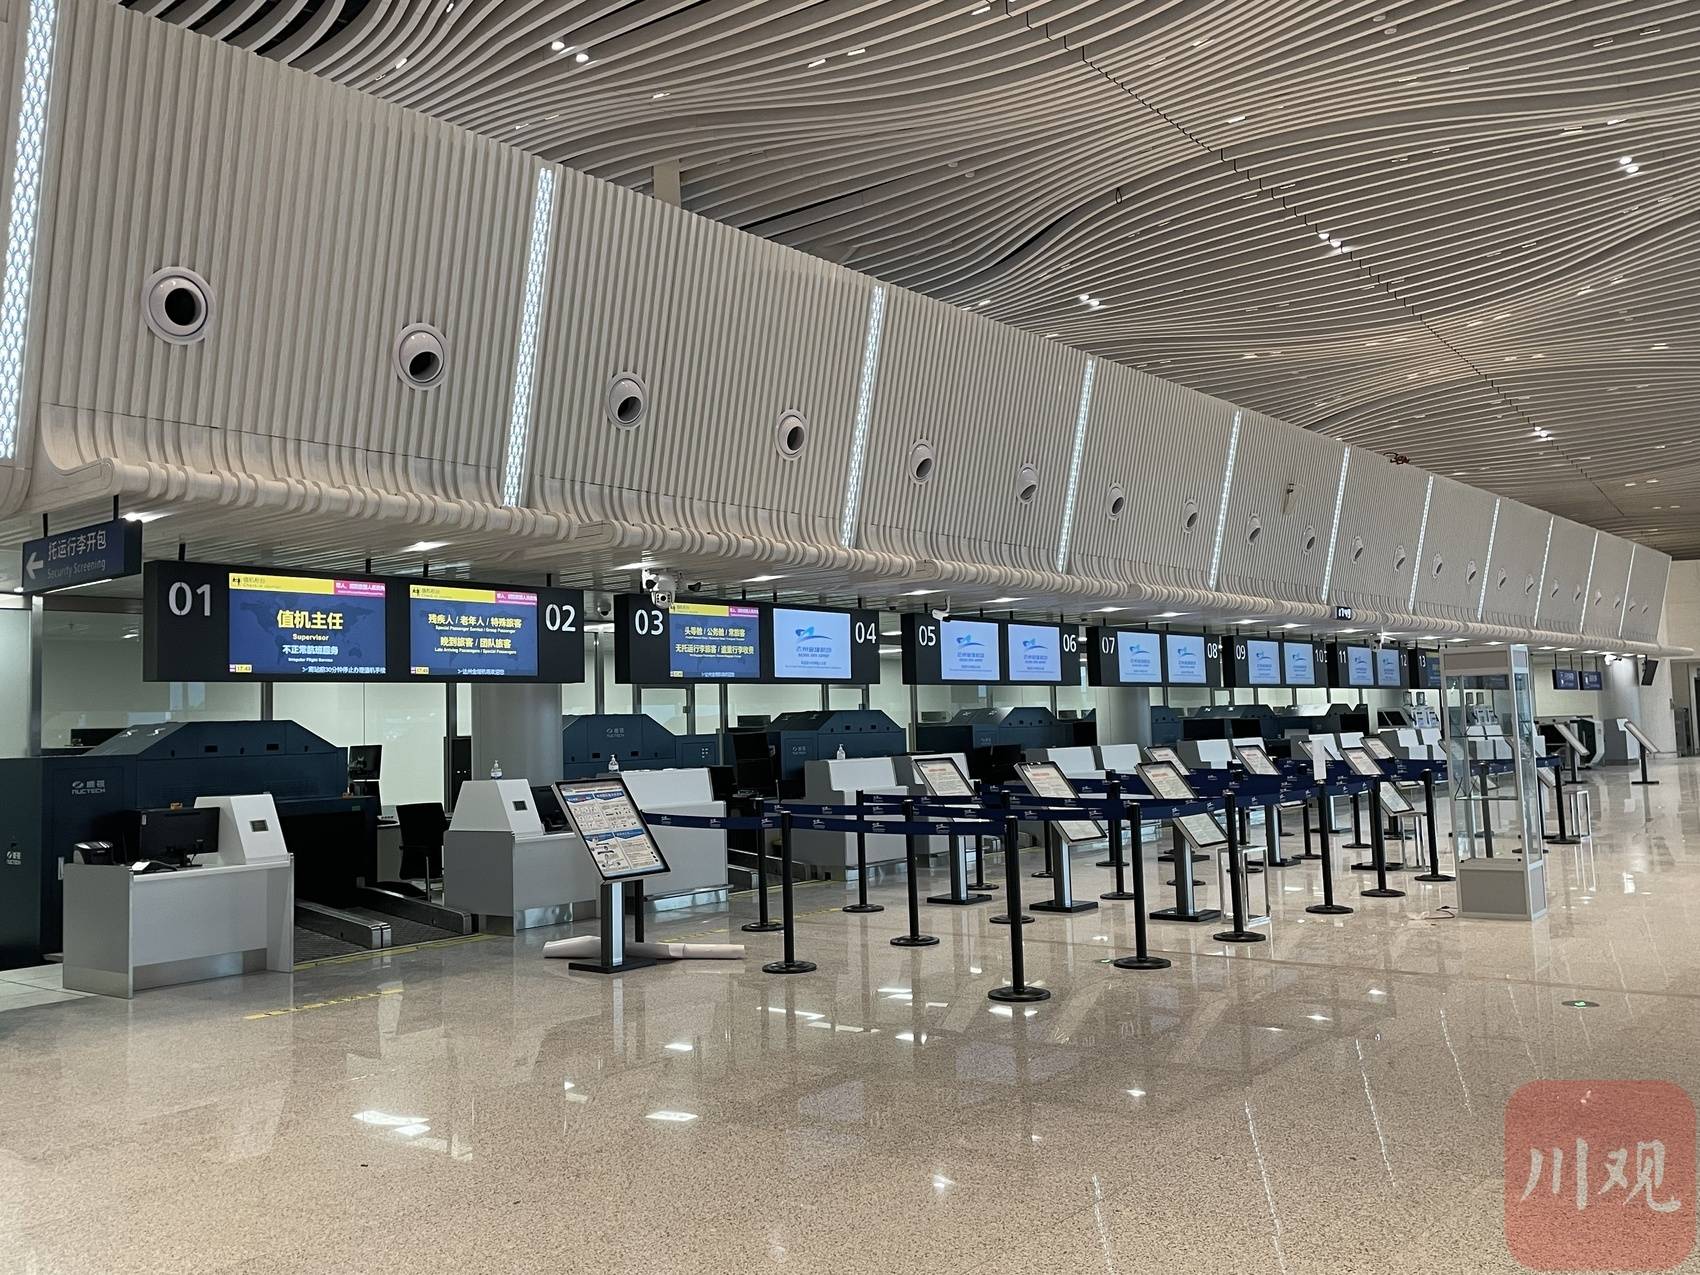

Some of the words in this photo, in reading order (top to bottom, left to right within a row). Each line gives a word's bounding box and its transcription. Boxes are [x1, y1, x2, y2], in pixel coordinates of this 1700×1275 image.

[48, 530, 106, 561] 托运行李开包
[47, 566, 72, 580] Security
[73, 559, 106, 576] Screening
[168, 581, 212, 616] 01
[276, 609, 344, 630] 值机主任
[428, 613, 454, 625] 残疾人
[460, 615, 485, 626] 老年人
[490, 616, 522, 629] 特殊旅客
[545, 604, 576, 632] 02
[634, 609, 664, 636] 03
[292, 633, 330, 642] Supervisor
[685, 627, 703, 636] 头等舱
[707, 627, 725, 637] 公务舱
[855, 621, 877, 644] 04
[918, 625, 936, 647] 05
[282, 644, 339, 656] 不正常航班服务
[440, 636, 474, 648] 晚到旅客
[480, 638, 512, 649] 团队旅客
[675, 644, 717, 654] 无托运行李旅客
[1062, 634, 1077, 653] 06
[1101, 636, 1115, 654] 07
[1207, 642, 1218, 659] 08
[1235, 644, 1246, 660] 09
[1315, 649, 1324, 663] 10
[1339, 650, 1347, 664] 11
[1400, 654, 1407, 667] 12
[1418, 655, 1426, 668] 13
